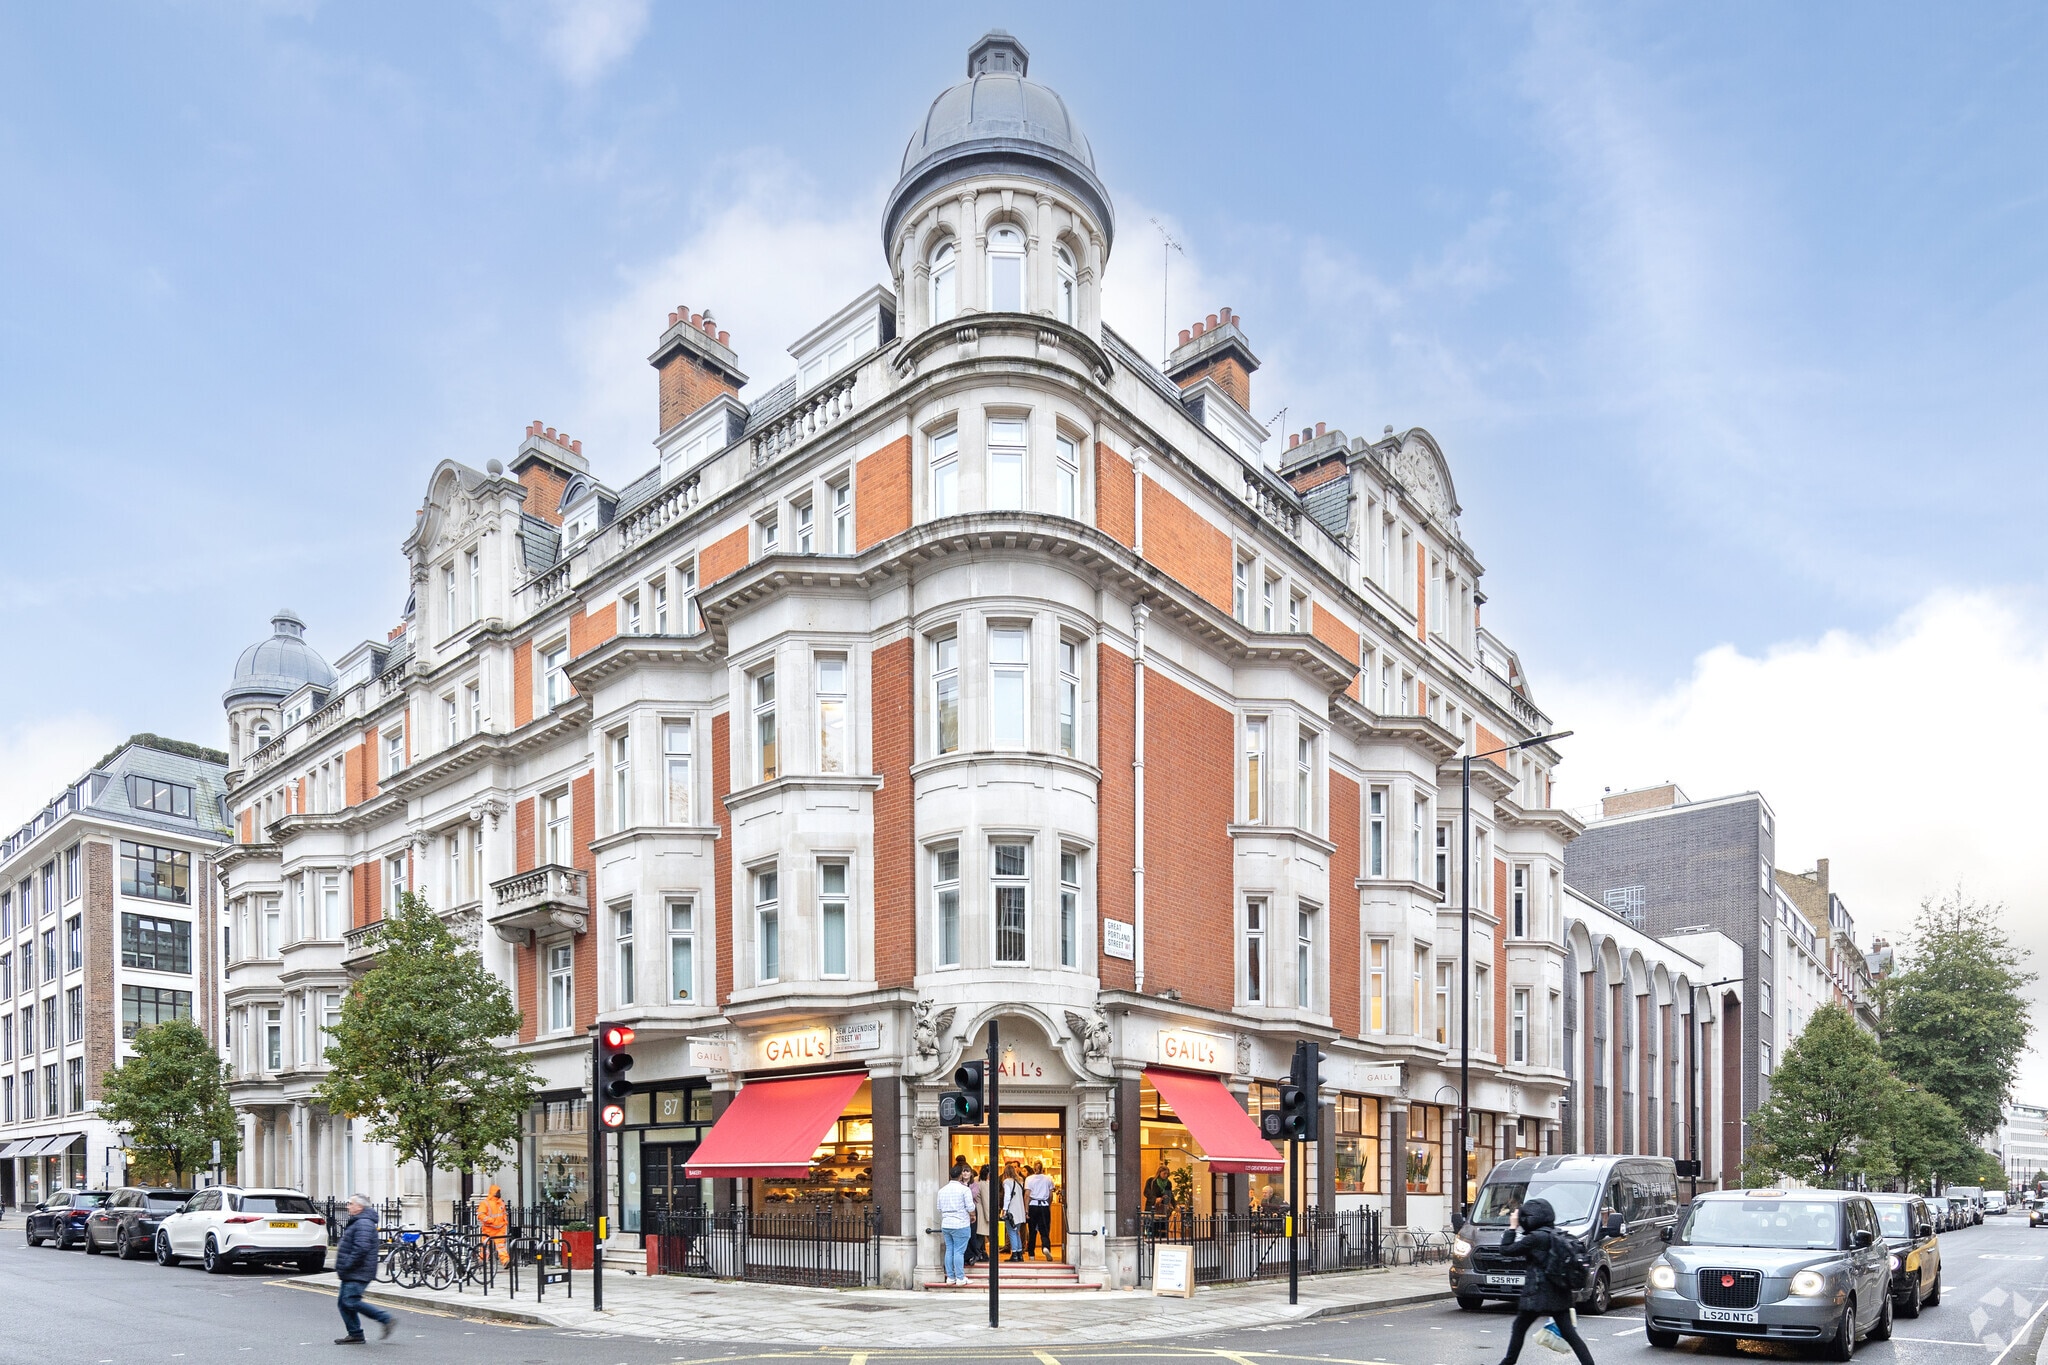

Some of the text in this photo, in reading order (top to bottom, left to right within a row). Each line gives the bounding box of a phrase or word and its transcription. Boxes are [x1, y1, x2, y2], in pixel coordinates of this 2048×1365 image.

[1108, 922, 1121, 931] GREAT
[1108, 930, 1130, 942] PORTLAND
[1108, 939, 1123, 949] STREET
[836, 1024, 877, 1035] NEW CAVENDISH
[835, 1034, 853, 1044] STREET
[767, 1036, 825, 1061] GAIL's
[1165, 1037, 1215, 1064] GAIL's
[697, 1052, 723, 1062] GAIL's
[1367, 1073, 1393, 1082] GAIL's
[663, 1098, 679, 1116] 87
[1491, 1276, 1505, 1284] S25
[1703, 1311, 1754, 1322] LS20 NTG
